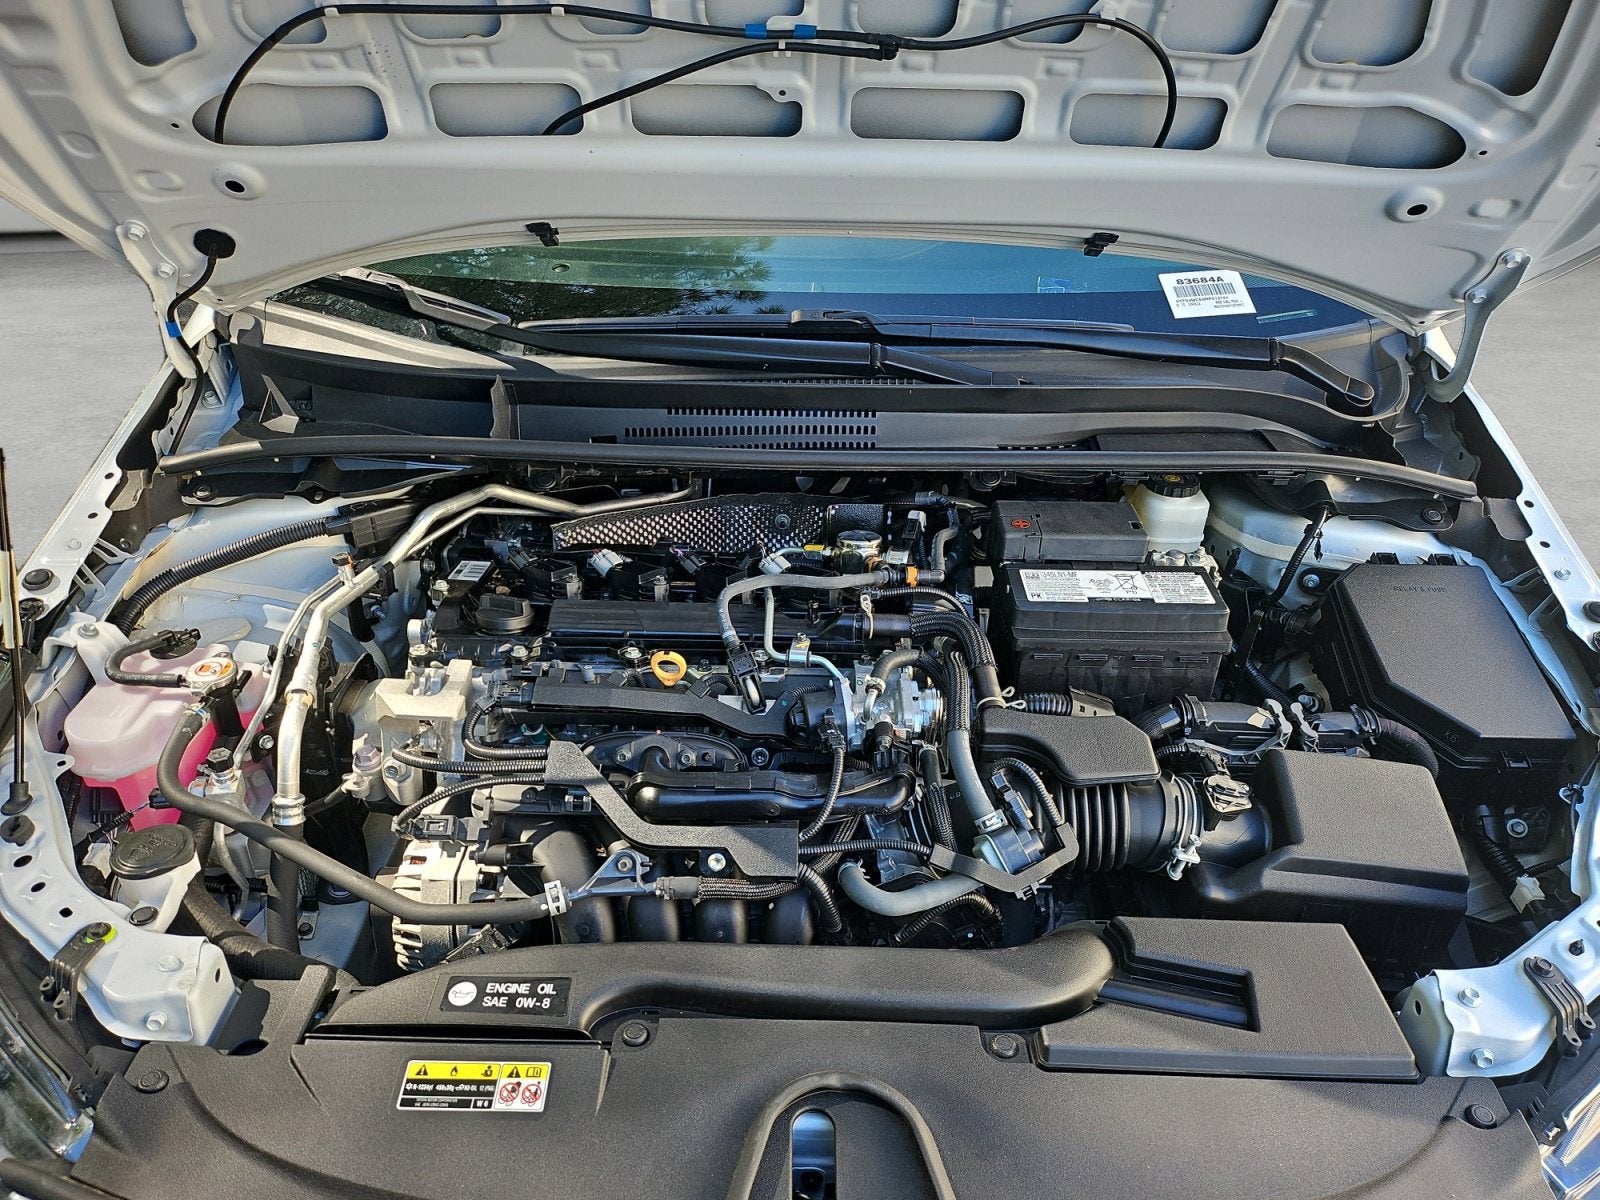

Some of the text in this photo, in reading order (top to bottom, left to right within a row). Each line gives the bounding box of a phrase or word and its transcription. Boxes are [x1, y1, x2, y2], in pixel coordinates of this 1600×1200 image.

[1176, 276, 1224, 285] 83684A
[486, 983, 557, 995] ENGINE OIL
[482, 996, 551, 1009] SAE 0W-8
